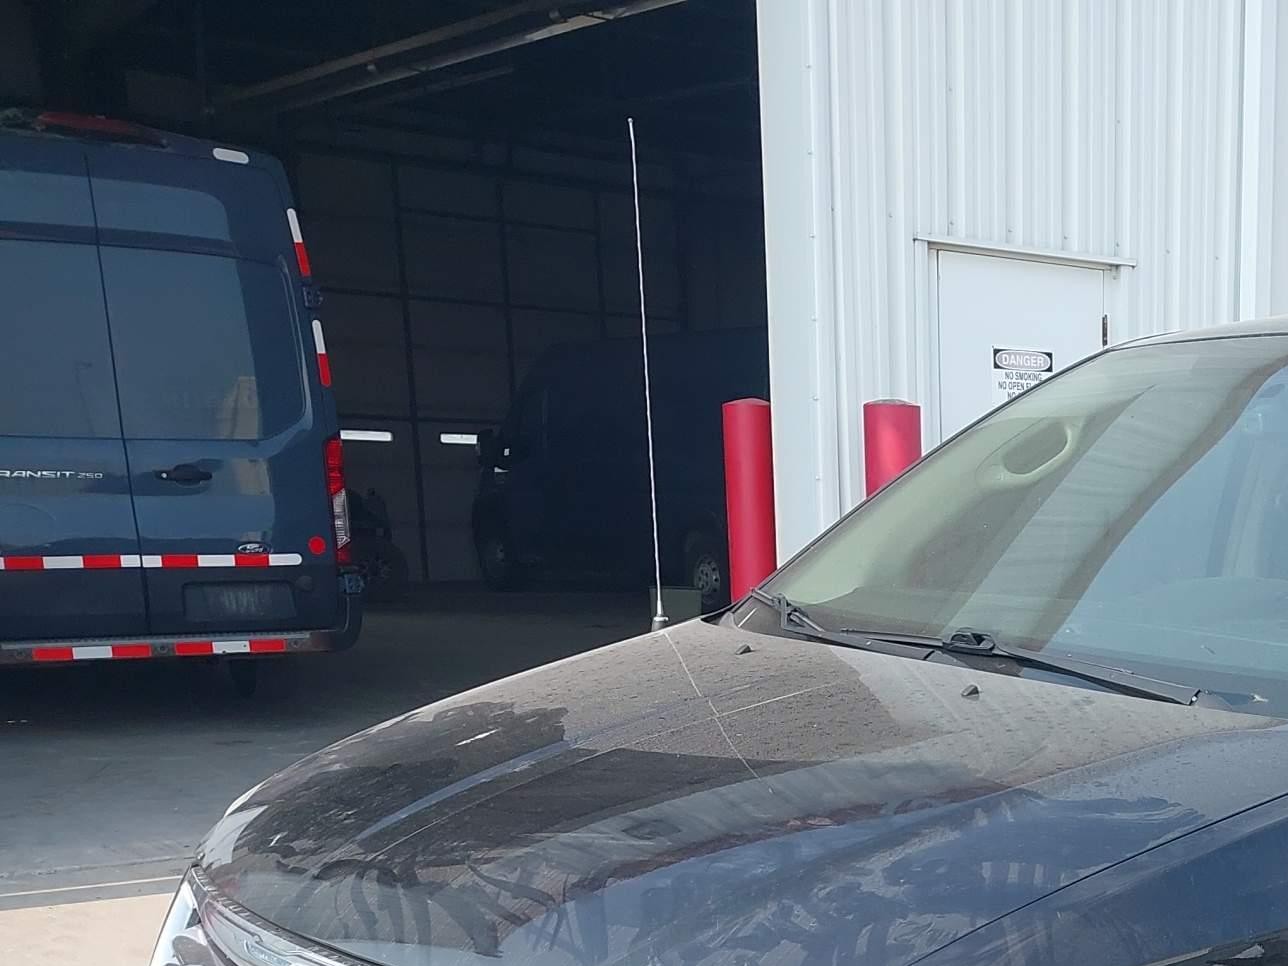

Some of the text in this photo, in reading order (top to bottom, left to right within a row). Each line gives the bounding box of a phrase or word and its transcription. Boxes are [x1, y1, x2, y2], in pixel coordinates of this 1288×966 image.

[1001, 353, 1045, 367] DANGER
[1004, 371, 1042, 381] NO SMOKING
[998, 381, 1007, 390] NO
[1008, 381, 1025, 391] OPEN
